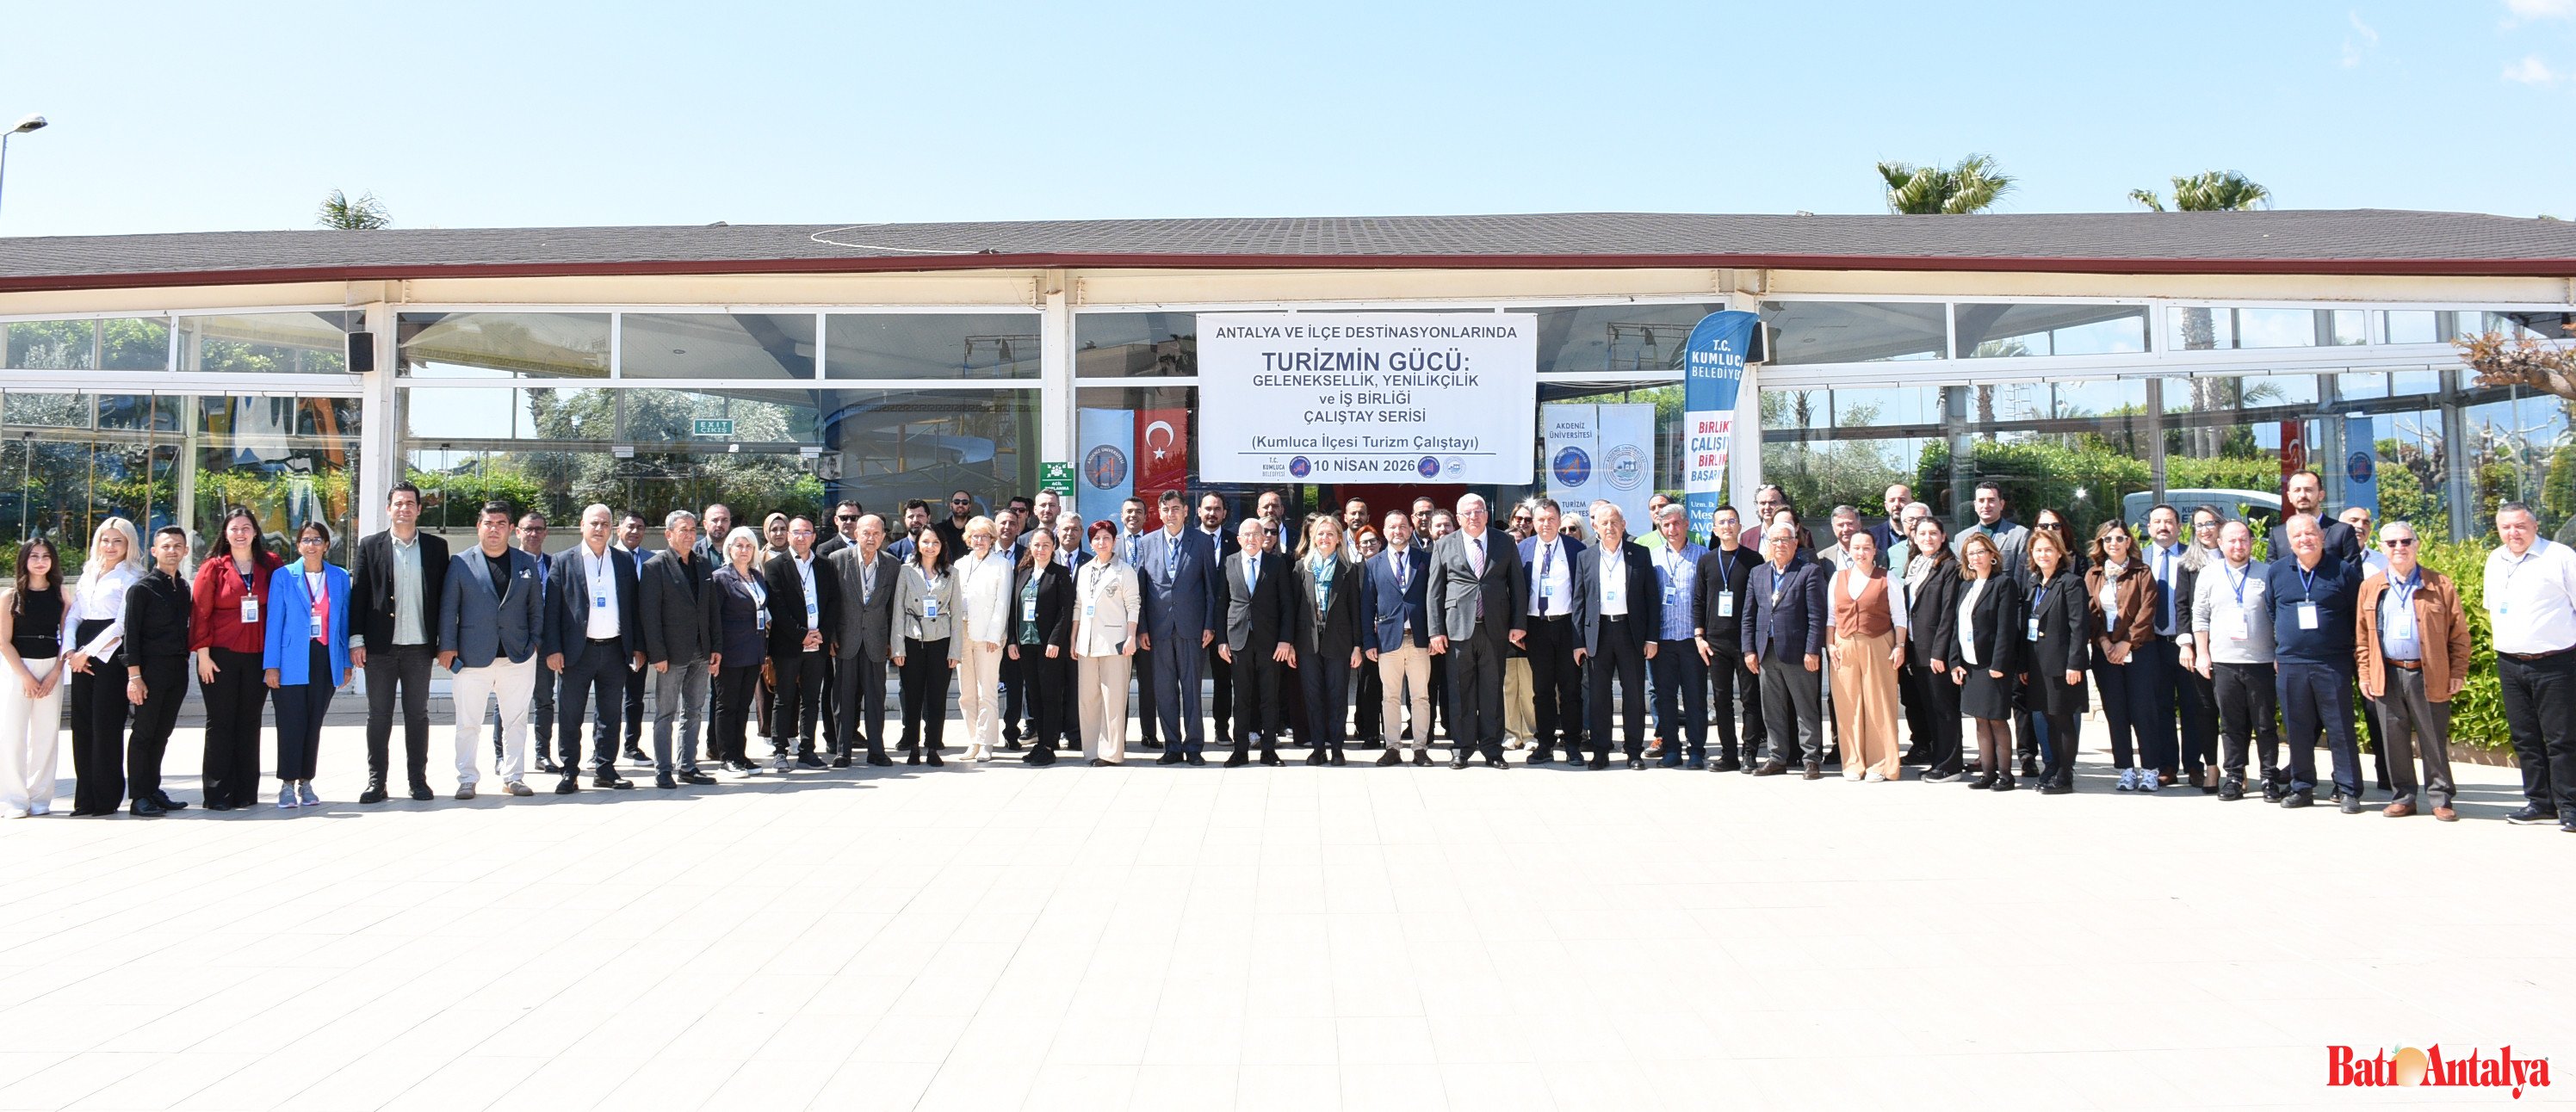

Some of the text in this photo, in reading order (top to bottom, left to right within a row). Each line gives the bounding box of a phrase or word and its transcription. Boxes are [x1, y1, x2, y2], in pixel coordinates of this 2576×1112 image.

[1216, 324, 1518, 341] ANTALYA VE İLÇE DESTİNASYONLARINDA
[1713, 339, 1731, 352] T.C.
[1261, 347, 1470, 372] TURİZMİN GÜCÜ:
[1253, 372, 1479, 390] GELENEKSELLİK, YENİLİKÇİLİK
[1319, 390, 1411, 408] ve İŞ BİRLİĞİ
[1303, 407, 1426, 425] ÇALIŞTAY SERİSİ
[1550, 430, 1592, 439] ÜNİVERSİTESİ
[1699, 420, 1731, 434] BİRLİK
[1252, 433, 1479, 451] (Kumluca İlçesi Turizm Çalıştayı)
[1691, 436, 1729, 453] ÇALIŞI
[1315, 460, 1329, 472] 10
[1334, 457, 1378, 472] NİSAN
[1383, 460, 1415, 472] 2026
[1691, 469, 1723, 482] BAŞARI
[1690, 510, 1713, 520] Mes
